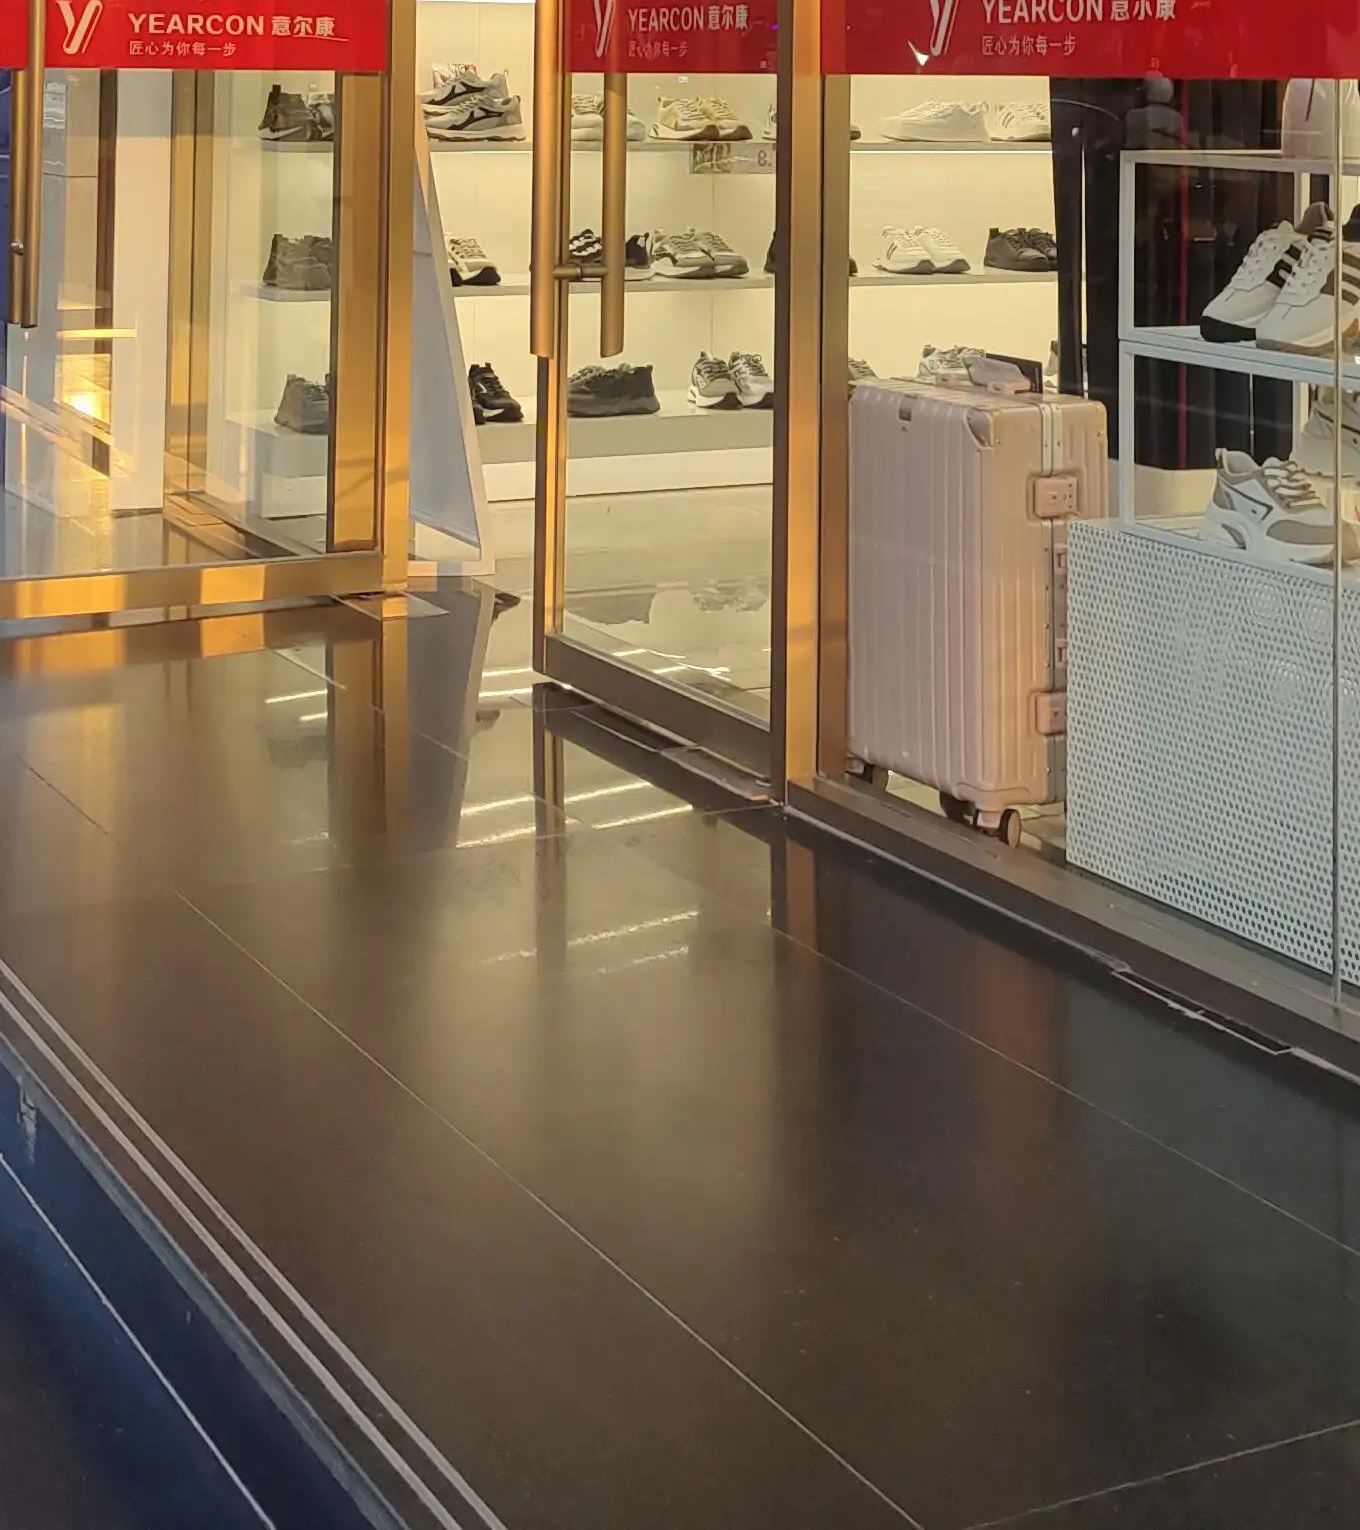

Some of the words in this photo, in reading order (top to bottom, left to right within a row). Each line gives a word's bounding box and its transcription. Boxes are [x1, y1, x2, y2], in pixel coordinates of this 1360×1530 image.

[128, 13, 264, 36] YEARCON
[271, 15, 336, 37] 意尔康
[628, 5, 704, 33] YEARCON
[707, 4, 749, 31] 意尔康
[129, 41, 237, 58] 匠心为你每一步
[981, 33, 1077, 56] 匠心为你每一步
